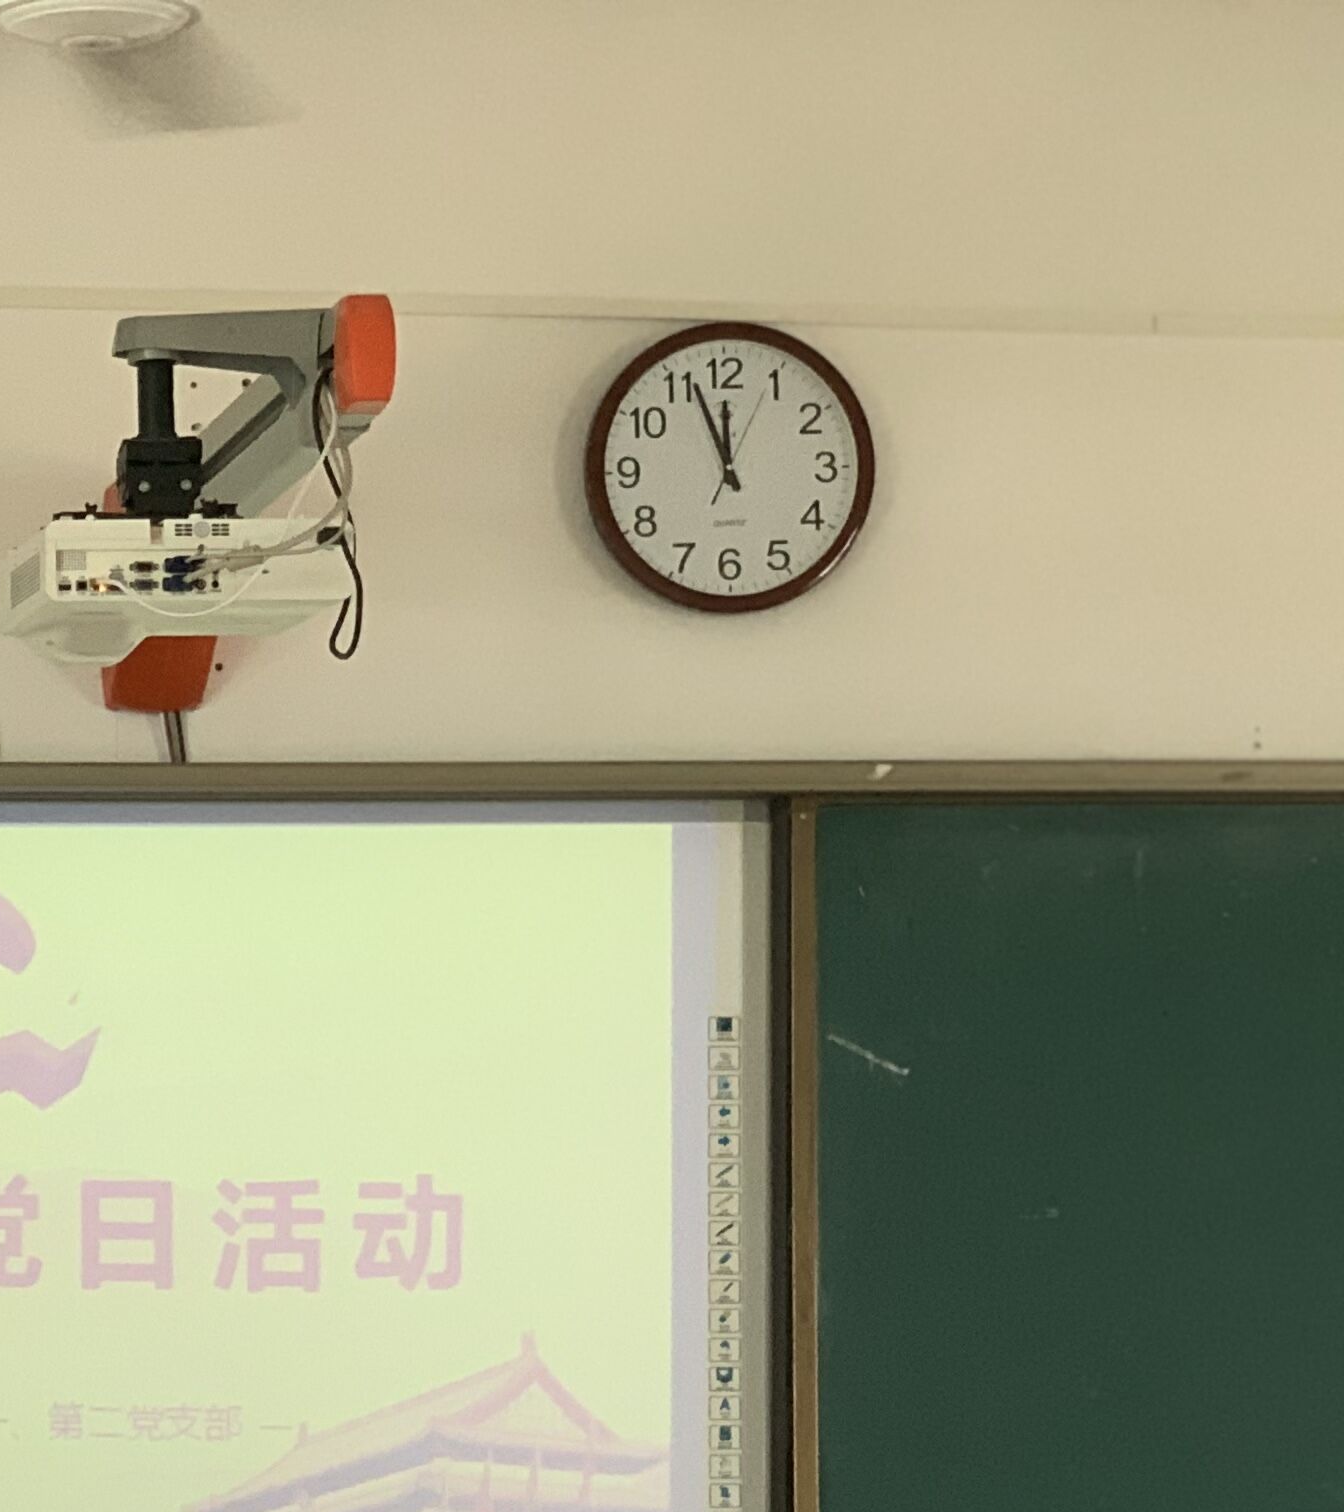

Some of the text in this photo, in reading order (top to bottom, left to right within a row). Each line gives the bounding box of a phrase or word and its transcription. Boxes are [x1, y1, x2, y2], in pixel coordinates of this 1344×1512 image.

[663, 371, 692, 403] 11
[706, 358, 743, 389] 12
[768, 368, 780, 400] 1
[629, 406, 667, 438] 10
[799, 403, 822, 434] 2
[617, 456, 641, 488] 9
[814, 451, 838, 482] 3
[633, 505, 657, 537] 8
[800, 500, 824, 530] 4
[672, 542, 696, 573] 7
[718, 549, 741, 580] 6
[767, 540, 790, 570] 5
